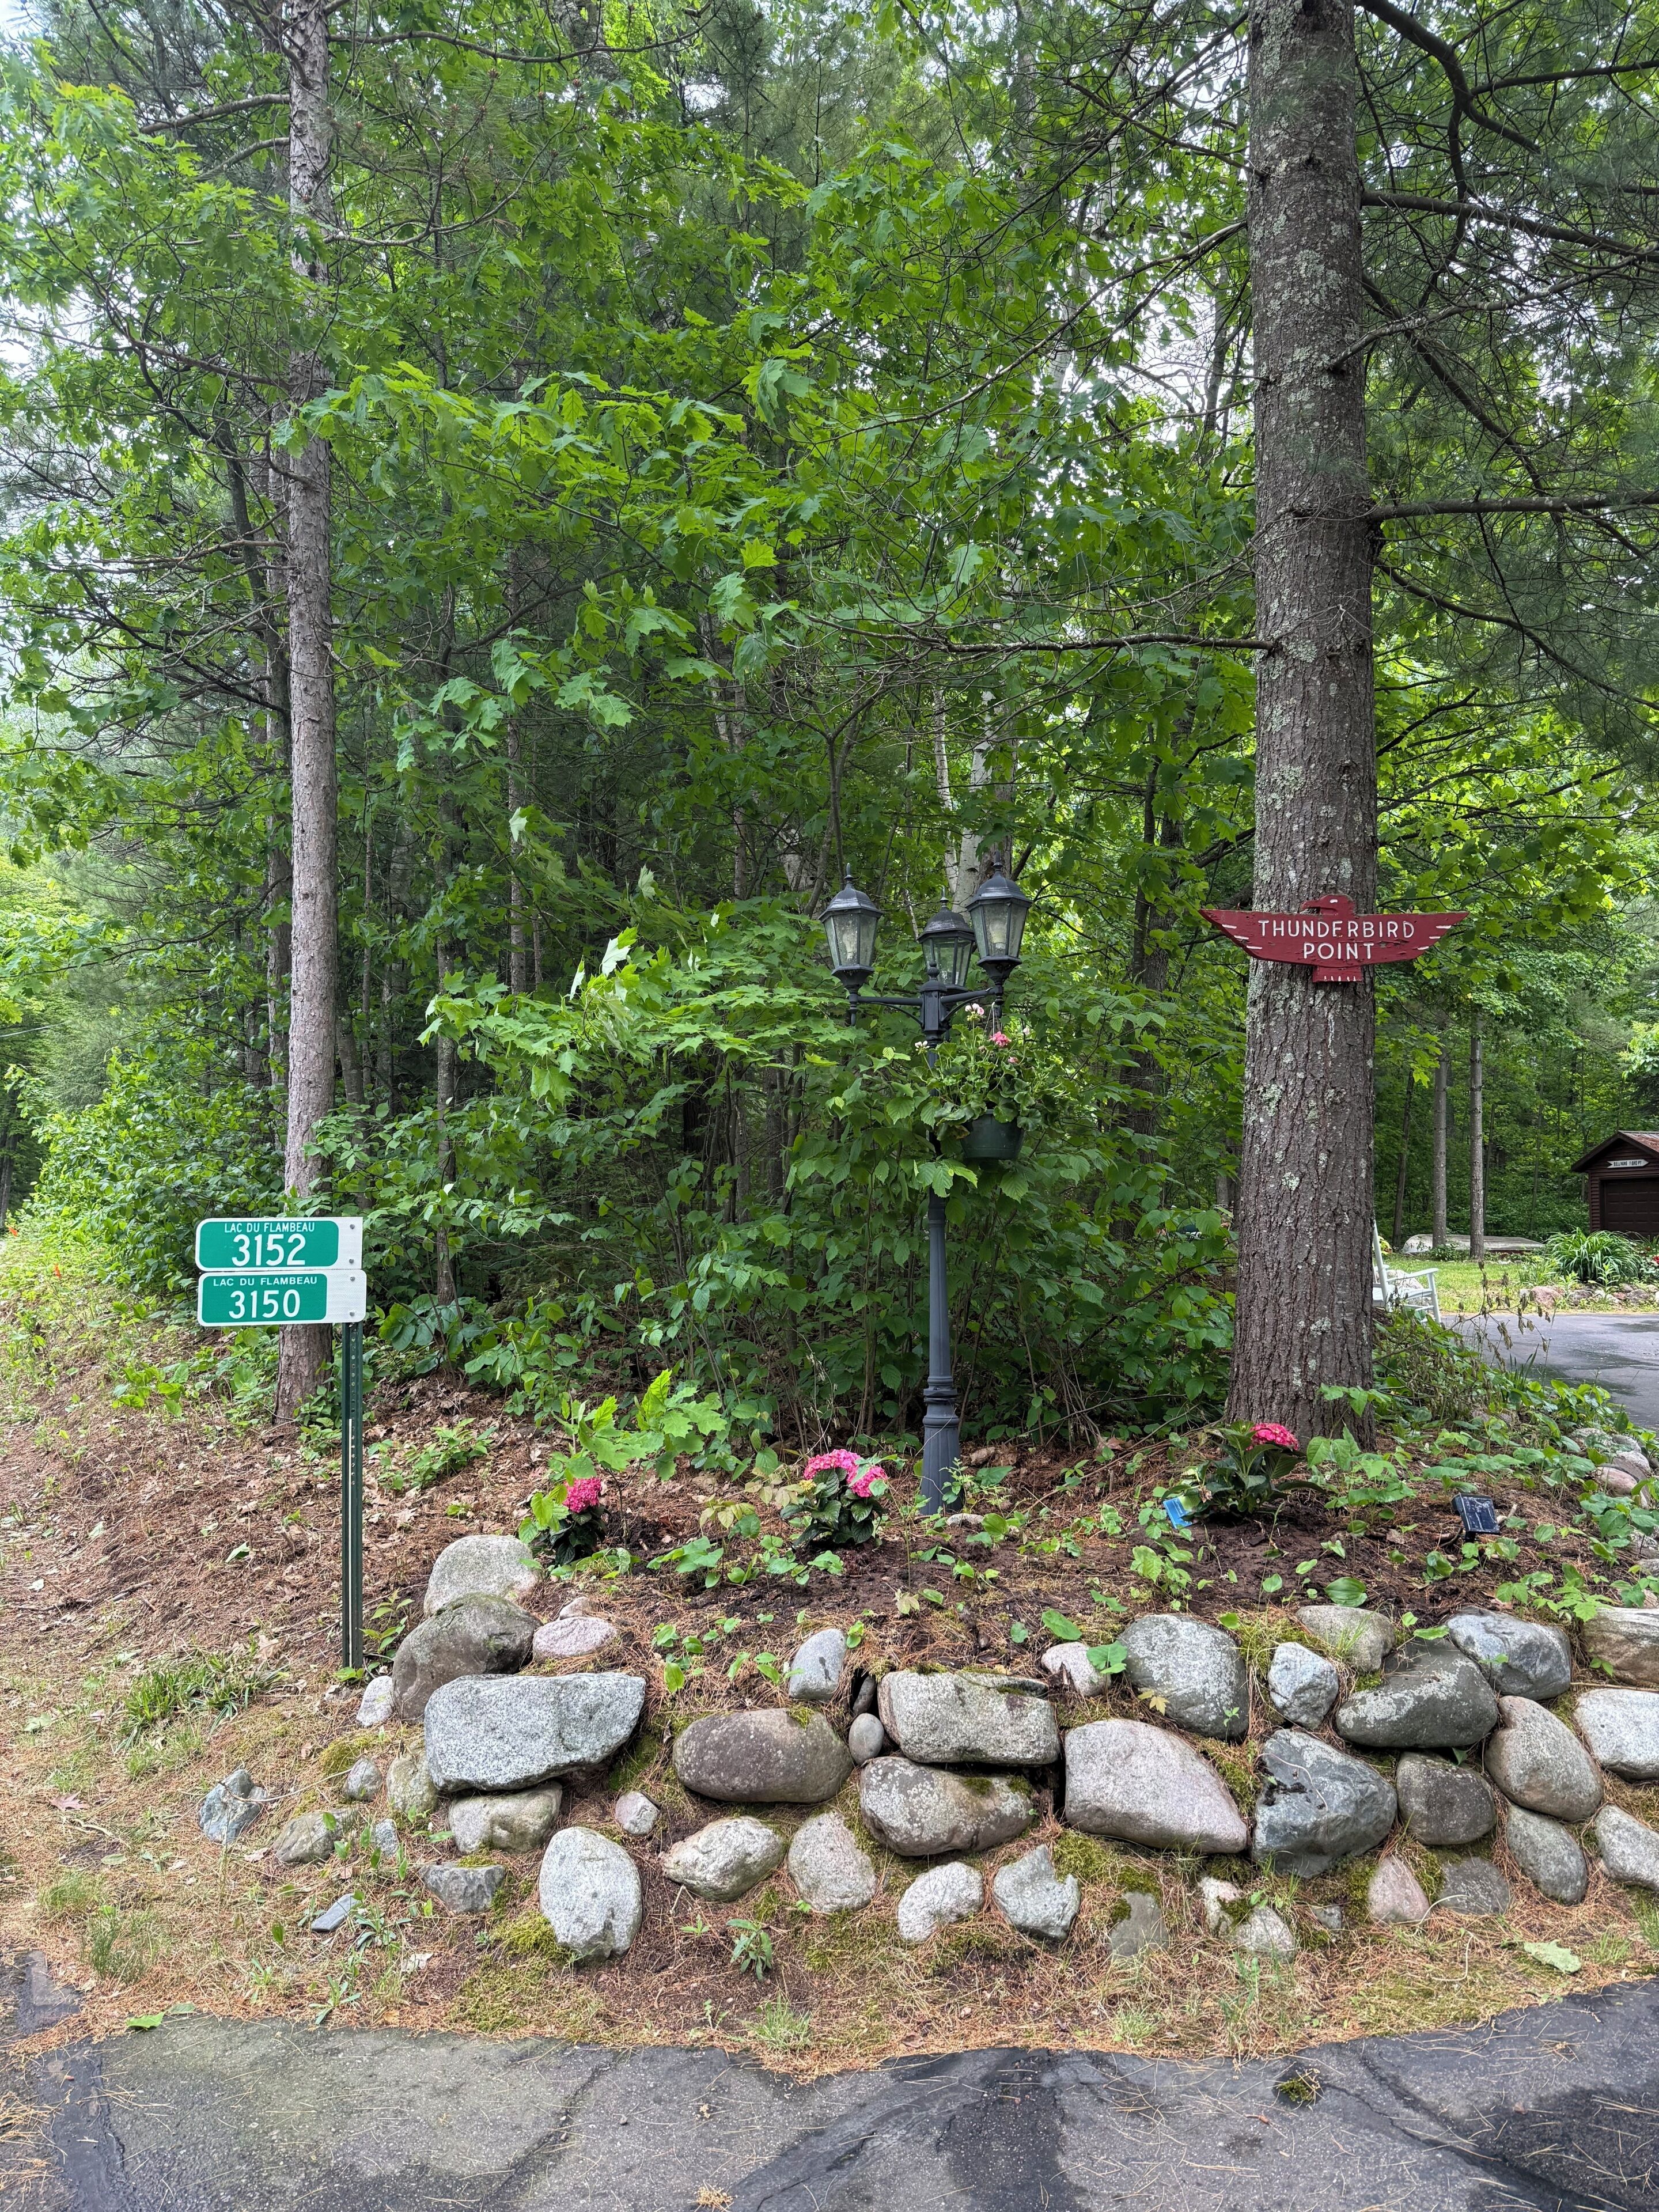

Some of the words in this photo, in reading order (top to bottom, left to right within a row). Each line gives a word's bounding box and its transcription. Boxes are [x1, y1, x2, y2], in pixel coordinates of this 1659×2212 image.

[1258, 920, 1415, 938] THUNDERBIRD
[1304, 942, 1374, 960] POINT
[224, 1223, 243, 1233] LAC
[247, 1222, 260, 1232] DU
[264, 1222, 315, 1233] FLAMBEAU
[232, 1233, 306, 1267] 3152
[213, 1278, 234, 1286] LAC
[240, 1278, 255, 1286] DU
[260, 1277, 317, 1285] FLAMBEAU
[229, 1289, 300, 1319] 3150
